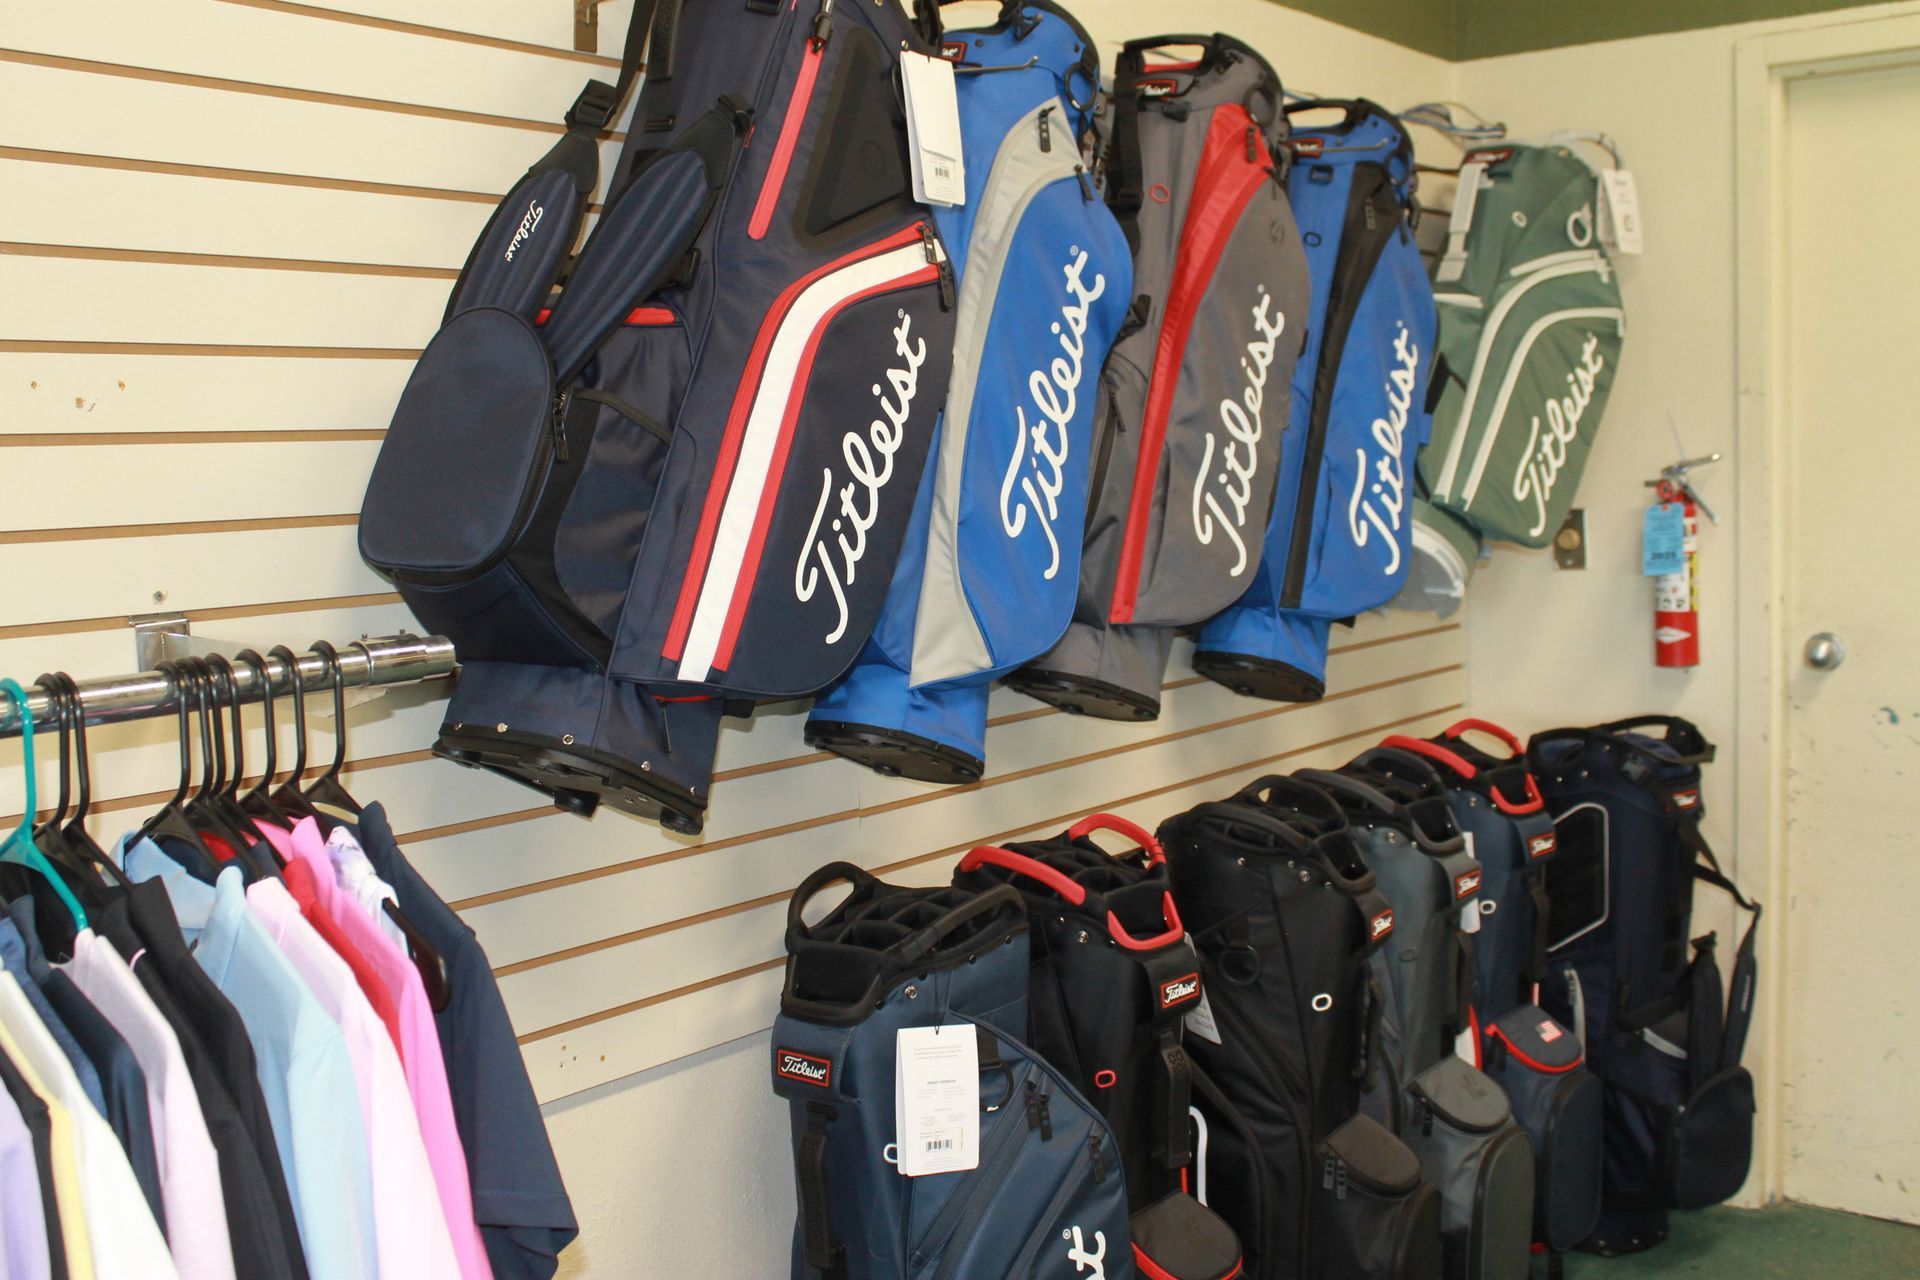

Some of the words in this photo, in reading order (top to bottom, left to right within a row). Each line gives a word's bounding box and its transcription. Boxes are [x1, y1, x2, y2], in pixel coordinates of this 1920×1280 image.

[505, 199, 544, 262] Titleist
[796, 313, 927, 645] Titleist
[1000, 250, 1106, 580] Titleist
[1193, 293, 1285, 577] Titleist
[1349, 328, 1418, 576] Titleist
[1513, 336, 1603, 538] Titleist
[781, 1055, 827, 1080] Titleist
